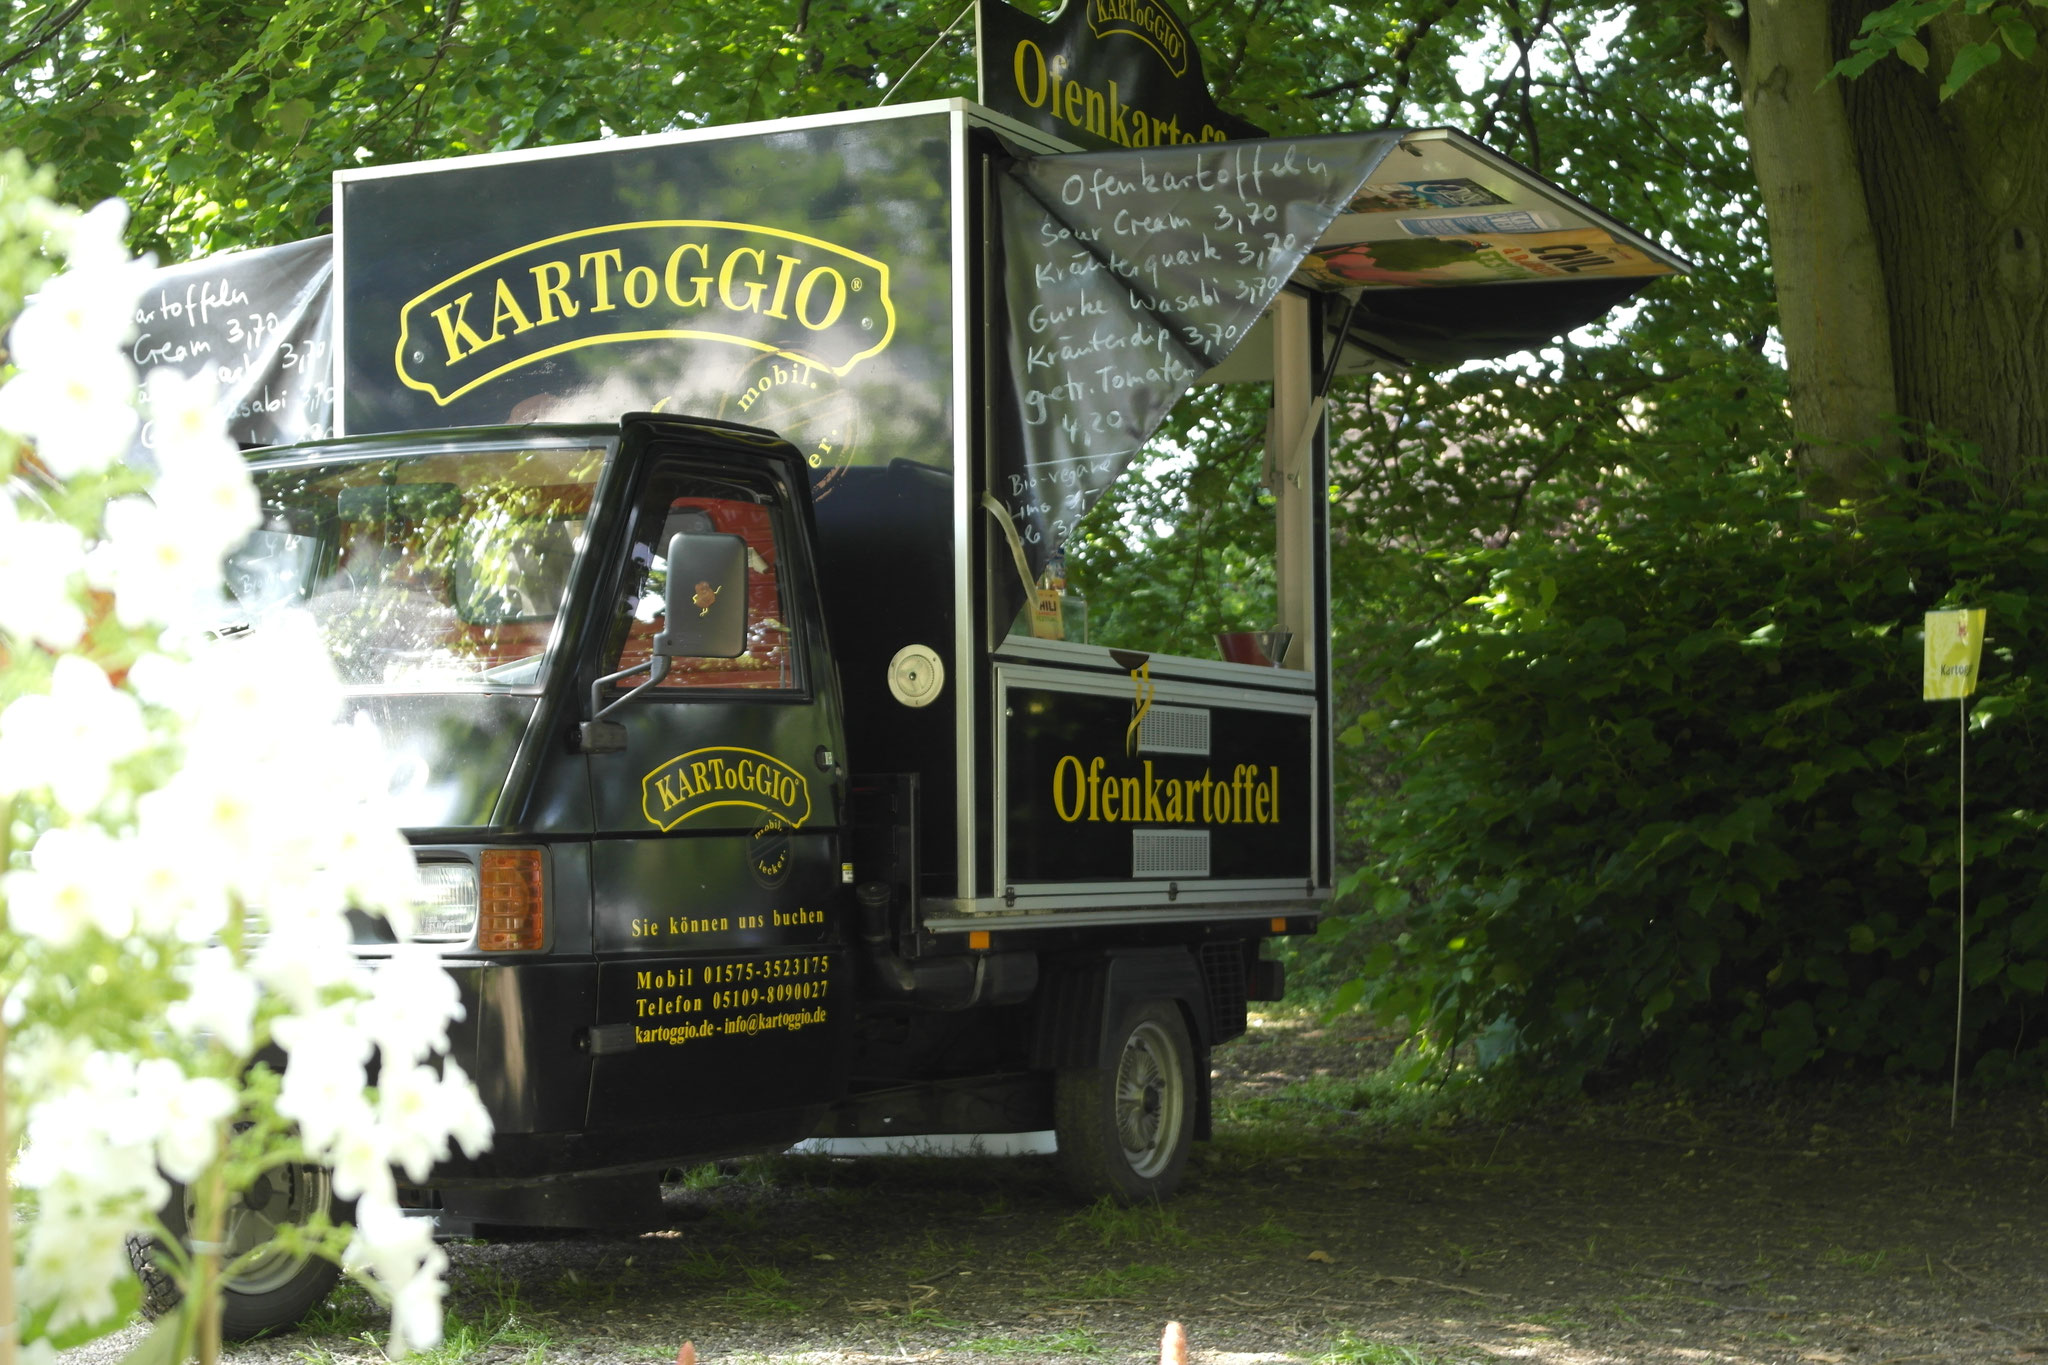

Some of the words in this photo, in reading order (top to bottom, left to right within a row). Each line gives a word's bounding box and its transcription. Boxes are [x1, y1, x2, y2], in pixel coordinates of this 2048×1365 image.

[1061, 144, 1328, 210] Ofenkartoffeln
[1041, 215, 1101, 247] Sour
[1114, 208, 1191, 236] Cream
[1214, 202, 1278, 234] 3,70
[1235, 232, 1296, 270] 3,70
[136, 278, 249, 327] artoffeln
[1028, 288, 1109, 333] Gurke
[1129, 277, 1221, 312] Wasabi
[1234, 276, 1278, 304] 3,70
[133, 333, 211, 365] Cream
[226, 311, 279, 350] 3,70
[1182, 322, 1237, 355] 3,70
[231, 384, 288, 419] asabi
[737, 362, 817, 412] mobil.
[1062, 409, 1122, 446] 4,20
[1053, 755, 1280, 824] Ofenkartoffel
[632, 918, 658, 937] Sie
[669, 916, 729, 934] können
[738, 914, 764, 929] uns
[773, 907, 825, 927] buchen
[636, 968, 693, 990] Mobil
[704, 955, 830, 984] 01575-3523175
[636, 995, 703, 1017] Telefon
[713, 980, 829, 1010] 05109-8090027
[635, 1019, 714, 1046] kartoggio.de
[724, 1006, 827, 1036] info@kartoggio.de
